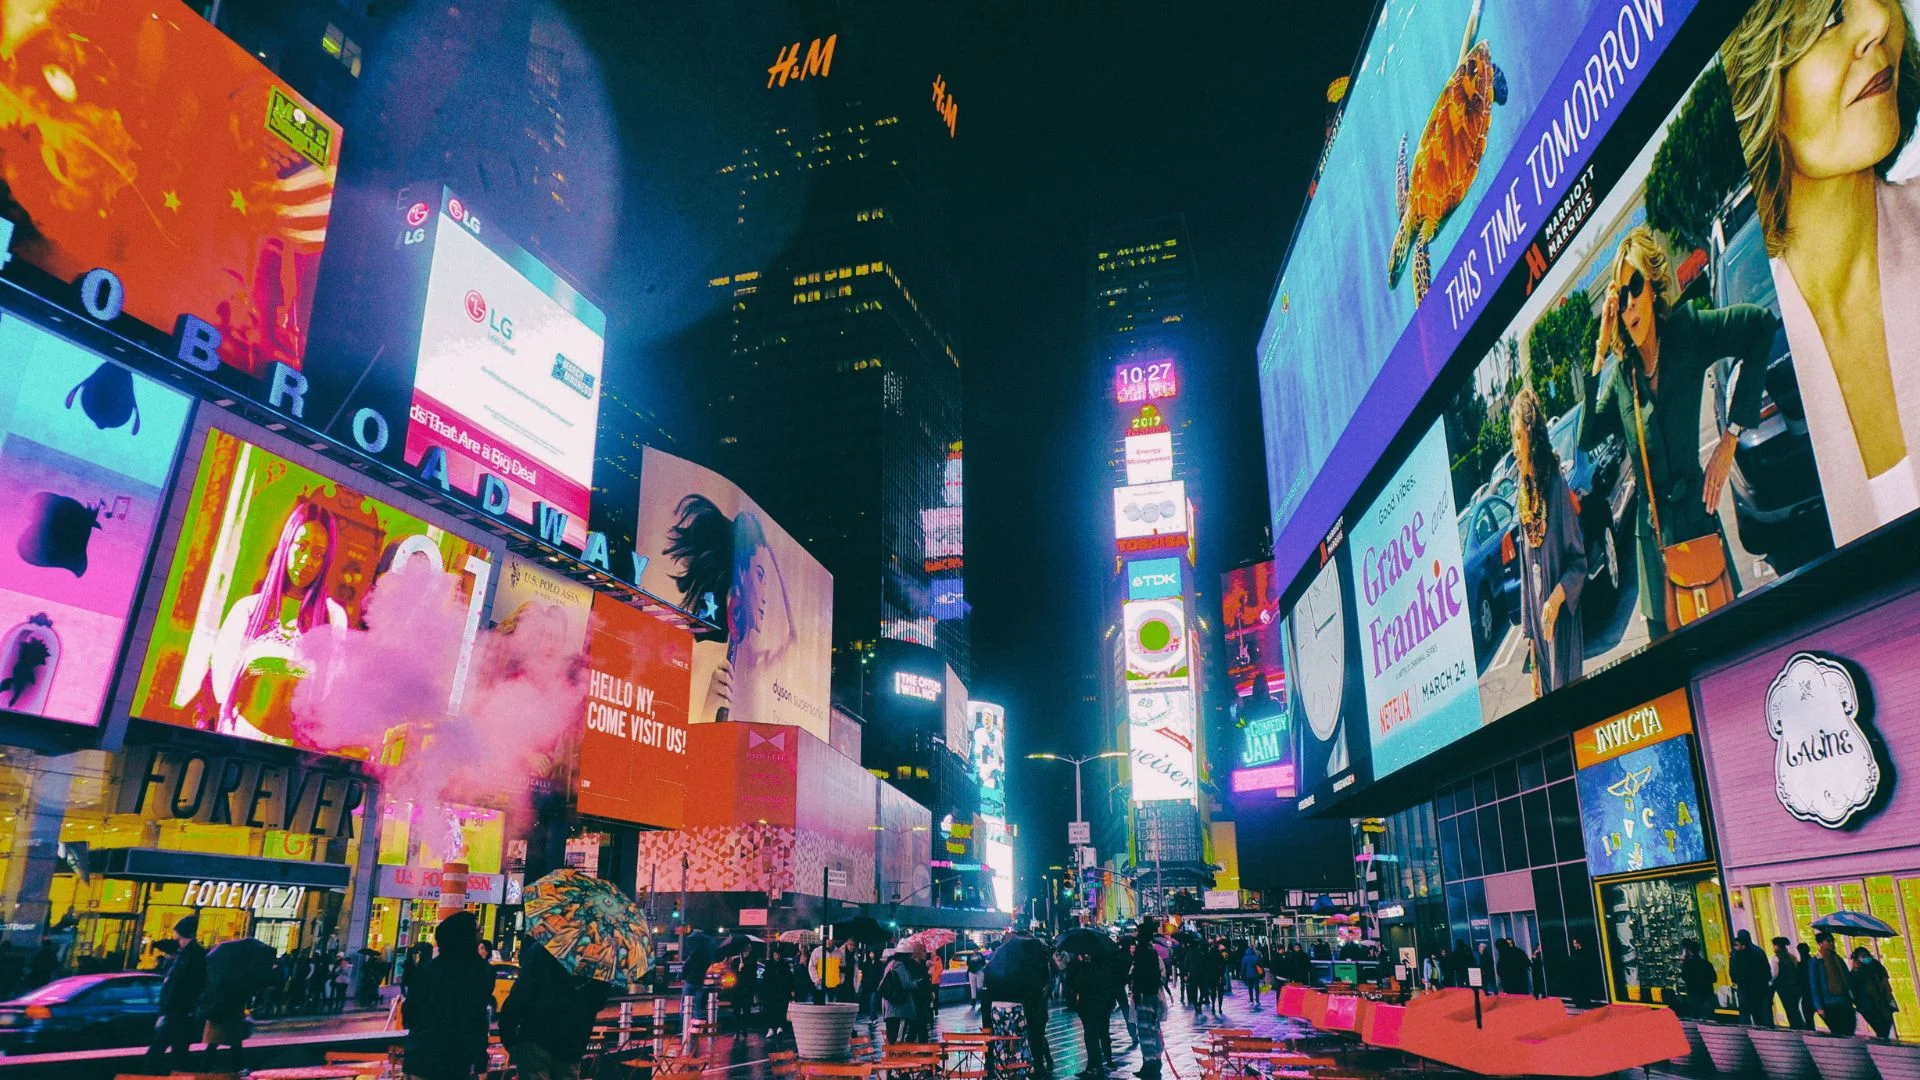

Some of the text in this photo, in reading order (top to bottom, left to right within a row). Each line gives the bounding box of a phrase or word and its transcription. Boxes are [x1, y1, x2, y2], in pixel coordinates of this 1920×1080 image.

[767, 34, 837, 88] H&M
[932, 74, 957, 138] H&M
[1445, 0, 1664, 330] THIS TIME TOMORROW
[463, 210, 481, 234] LG
[1545, 164, 1595, 239] MARRIOTT
[1547, 192, 1594, 255] MARQUIS
[404, 229, 425, 245] LG
[490, 308, 513, 340] LG
[1120, 363, 1172, 385] 10:27
[1132, 416, 1161, 428] 2017
[1378, 493, 1396, 525] Good
[1363, 473, 1449, 607] Grace and
[1141, 573, 1177, 586] TDK
[1368, 558, 1462, 679] Frankie
[589, 669, 656, 720] HELLO NY,
[772, 678, 792, 704] dyson
[1380, 659, 1467, 736] NETFLIX MARCH 24
[587, 701, 687, 755] COME VISIT US!
[1242, 732, 1280, 764] JAM
[1592, 705, 1663, 754] INVICTA
[134, 745, 367, 839] FOREVER
[182, 879, 306, 910] FOREVER 21
[463, 875, 492, 891] SSN.
